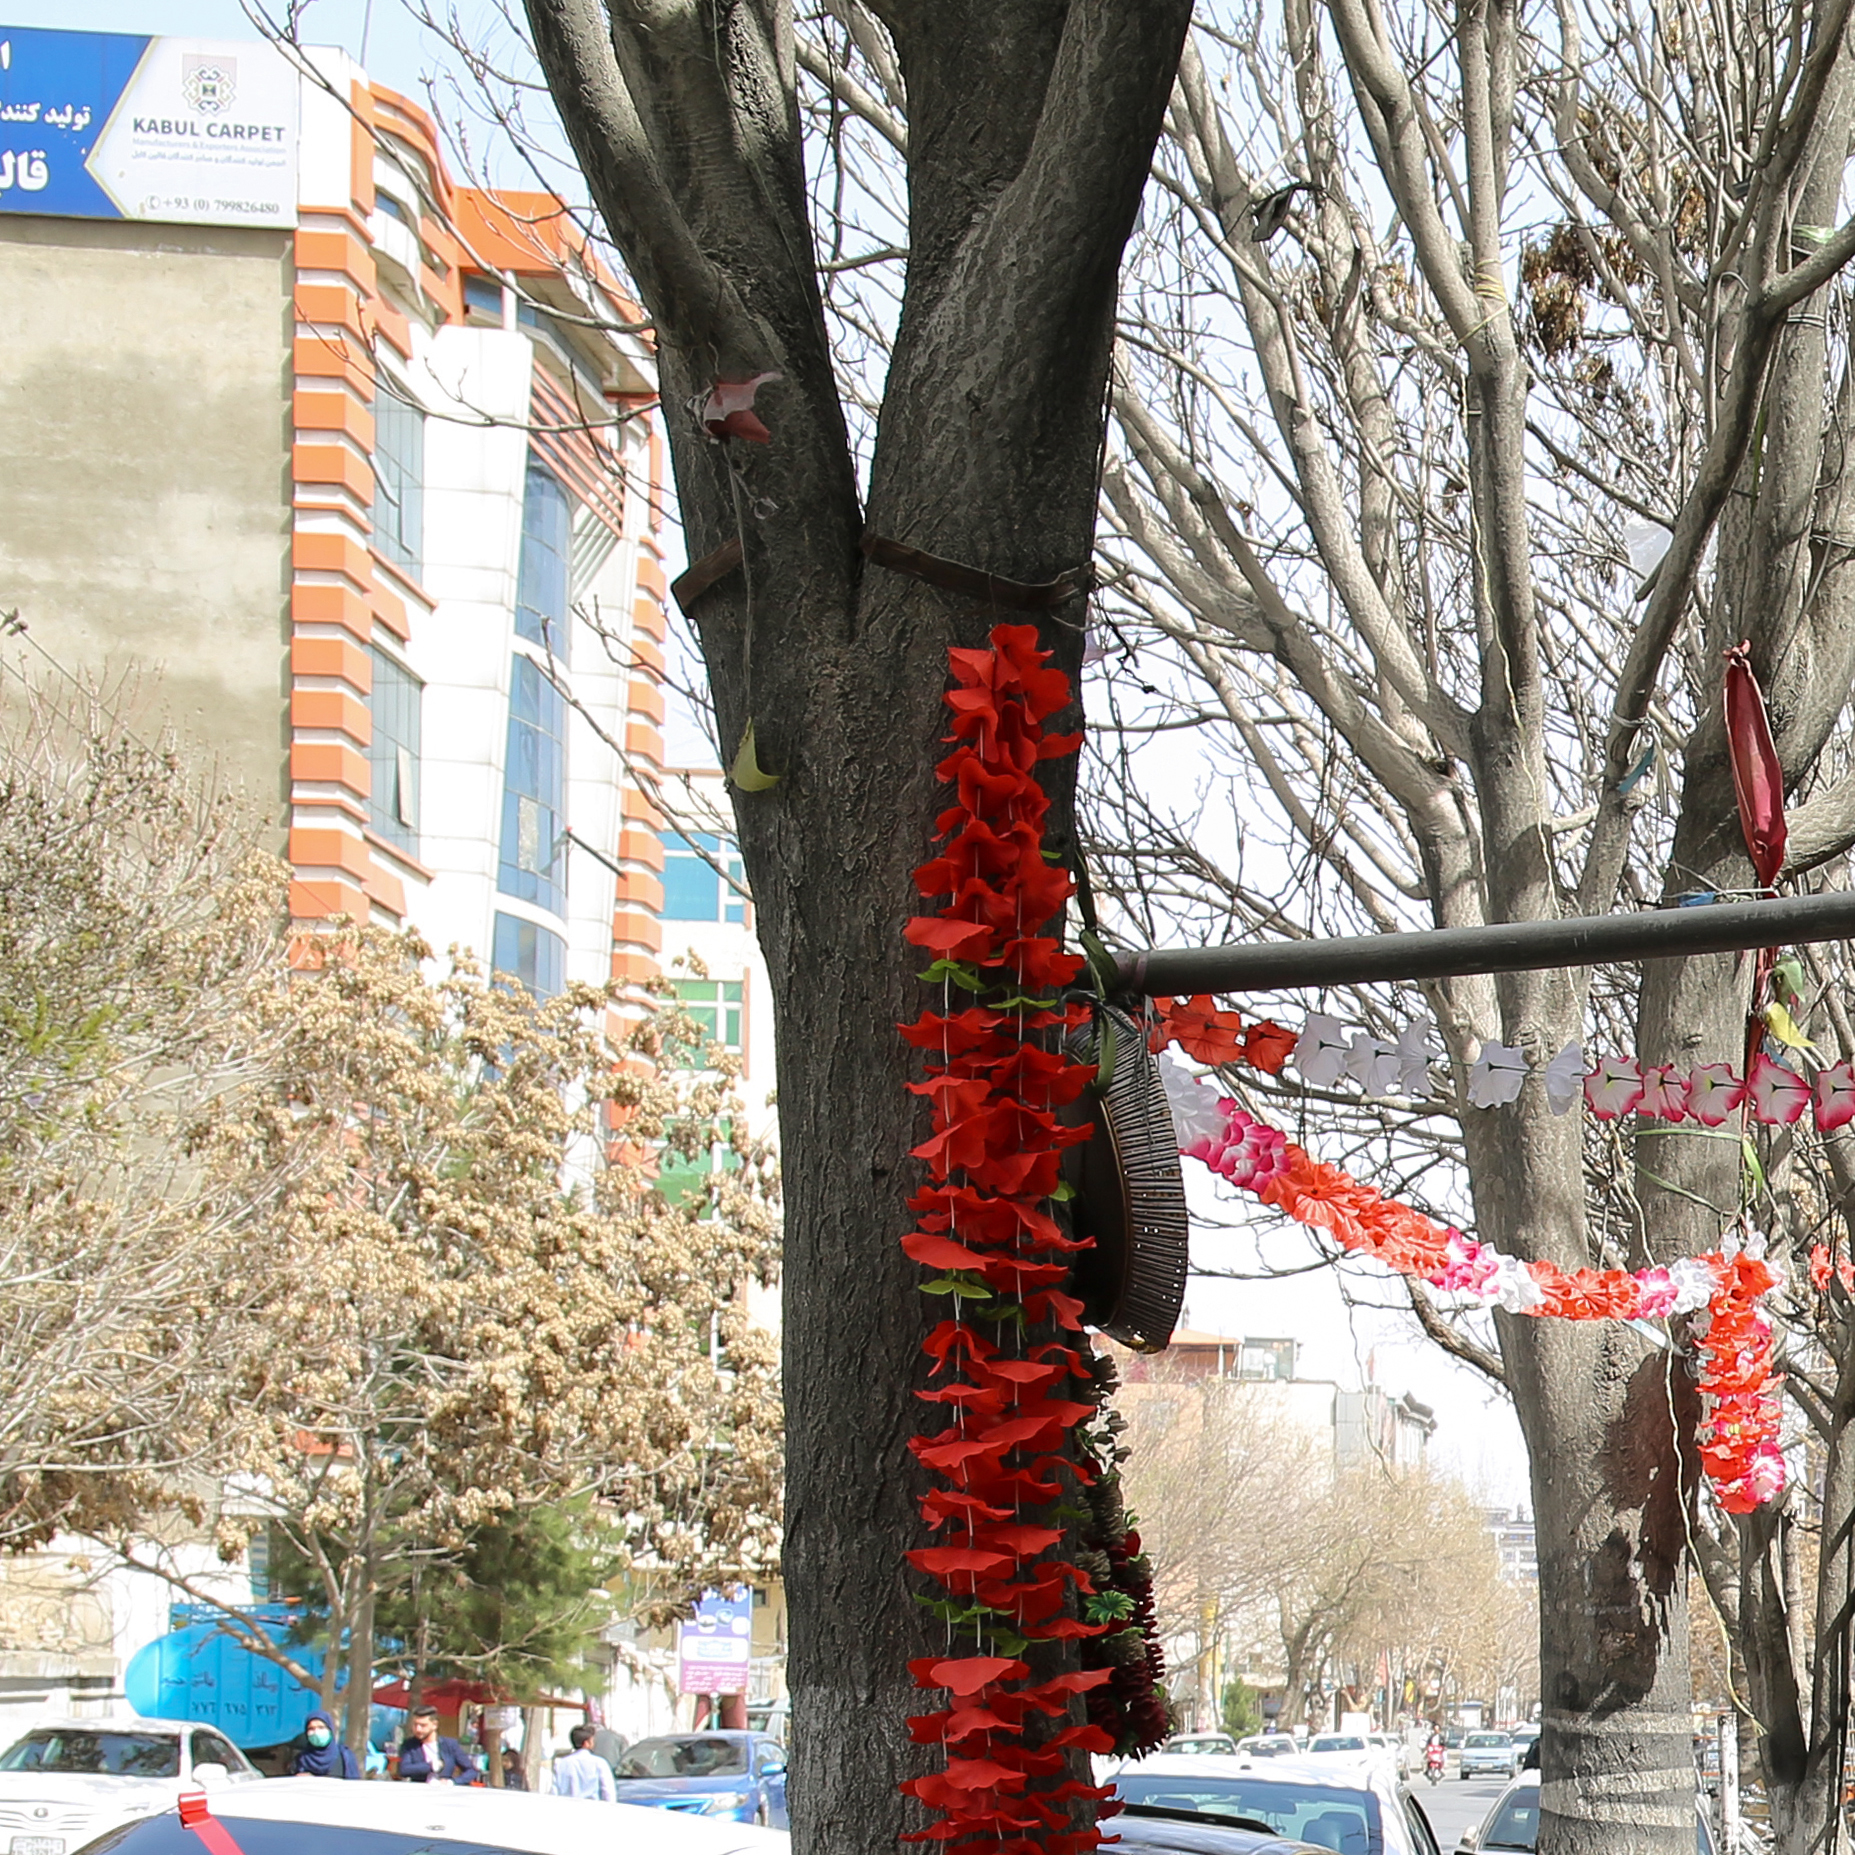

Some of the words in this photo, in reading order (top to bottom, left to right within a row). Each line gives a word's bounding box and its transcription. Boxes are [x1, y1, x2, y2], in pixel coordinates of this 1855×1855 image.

[0, 101, 41, 122] کنند
[132, 117, 200, 137] KABUL
[206, 122, 286, 142] CARPET
[193, 198, 210, 212] (0)
